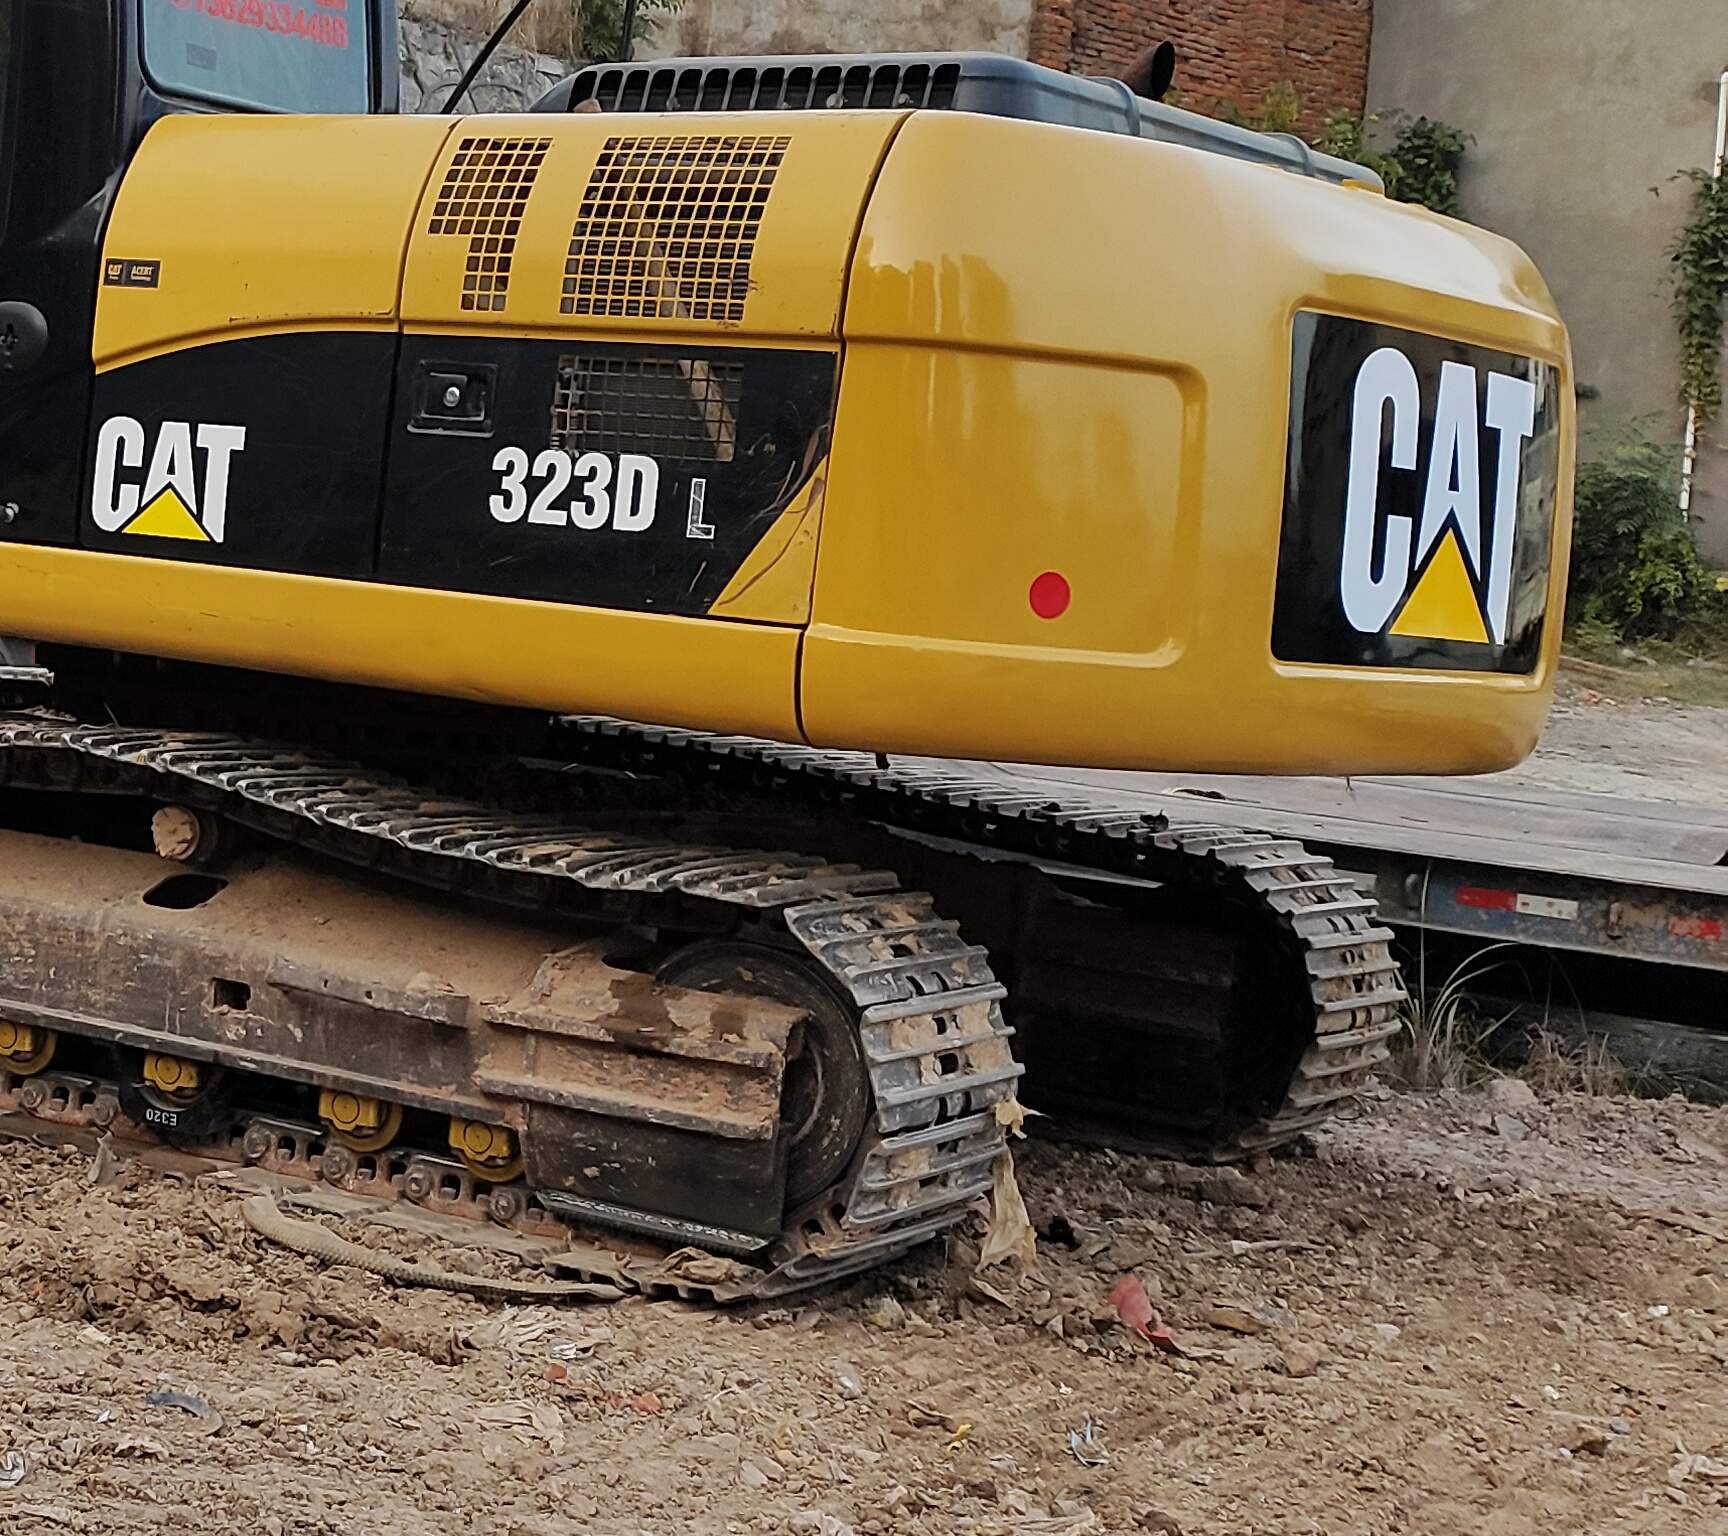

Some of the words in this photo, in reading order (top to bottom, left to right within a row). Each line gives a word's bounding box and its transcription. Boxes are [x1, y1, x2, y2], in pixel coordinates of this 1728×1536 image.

[90, 416, 246, 544] CAT
[489, 446, 660, 532] 323D
[686, 478, 716, 540] L
[1340, 347, 1535, 647] CAT
[145, 1108, 177, 1126] E320
